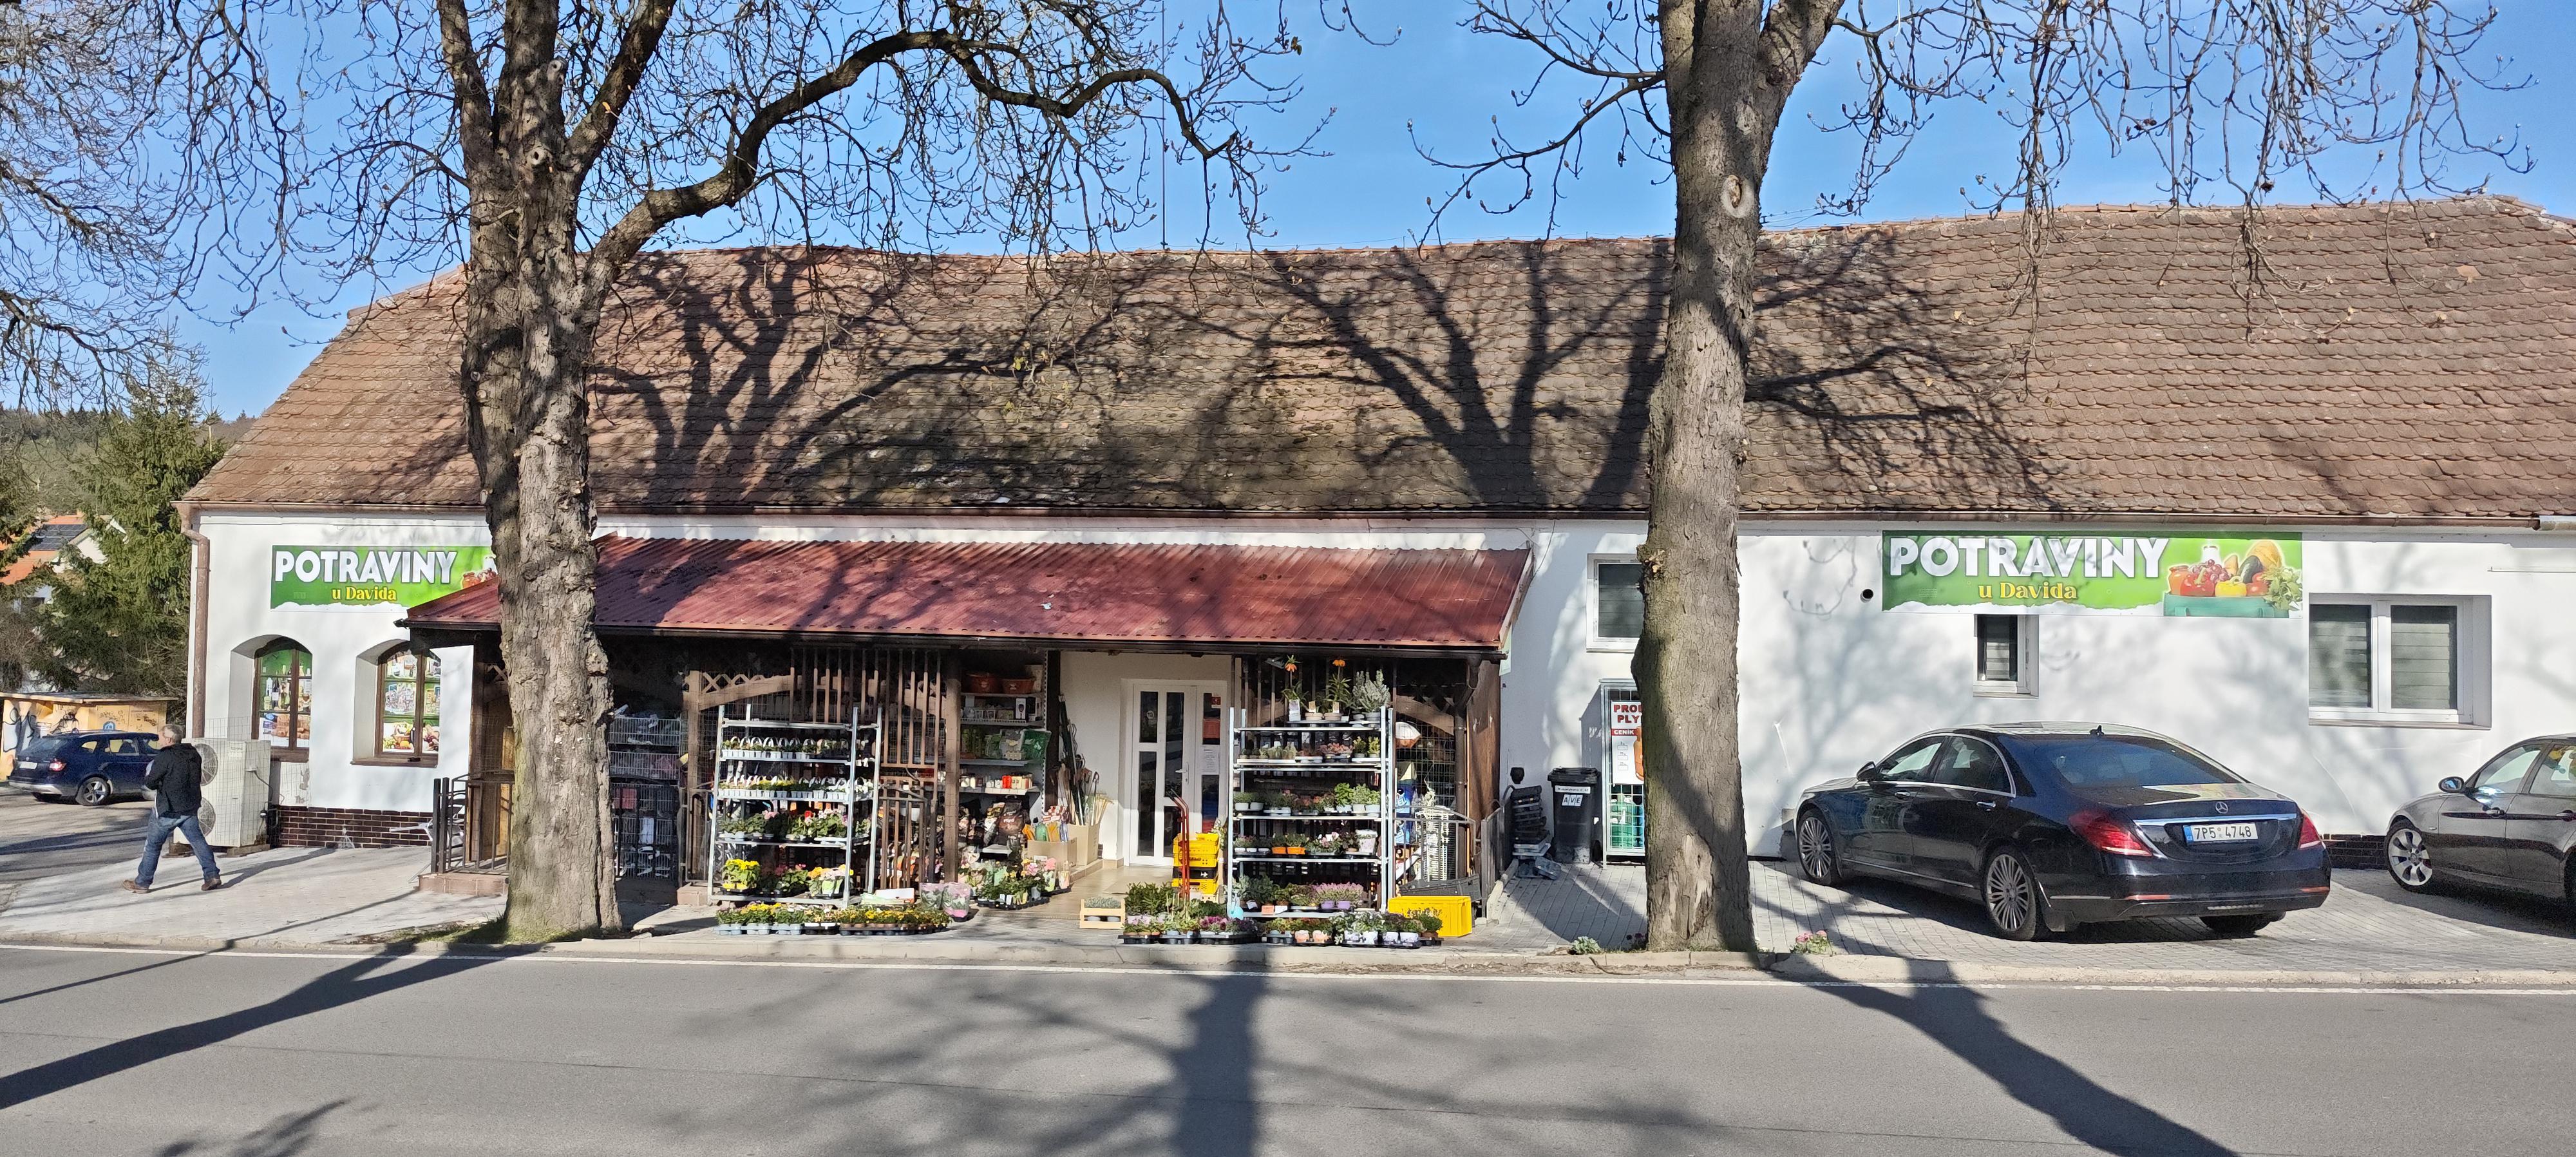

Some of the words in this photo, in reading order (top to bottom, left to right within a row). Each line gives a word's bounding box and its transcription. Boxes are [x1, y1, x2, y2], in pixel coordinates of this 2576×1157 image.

[274, 550, 457, 584] POTRAVINY
[1889, 537, 2169, 578] POTRAVINY
[332, 589, 341, 600] u
[346, 586, 397, 601] Davida
[1978, 585, 1992, 599] u
[2000, 581, 2078, 600] Davida
[2193, 827, 2217, 840] 7P5
[2224, 825, 2252, 838] 4748
